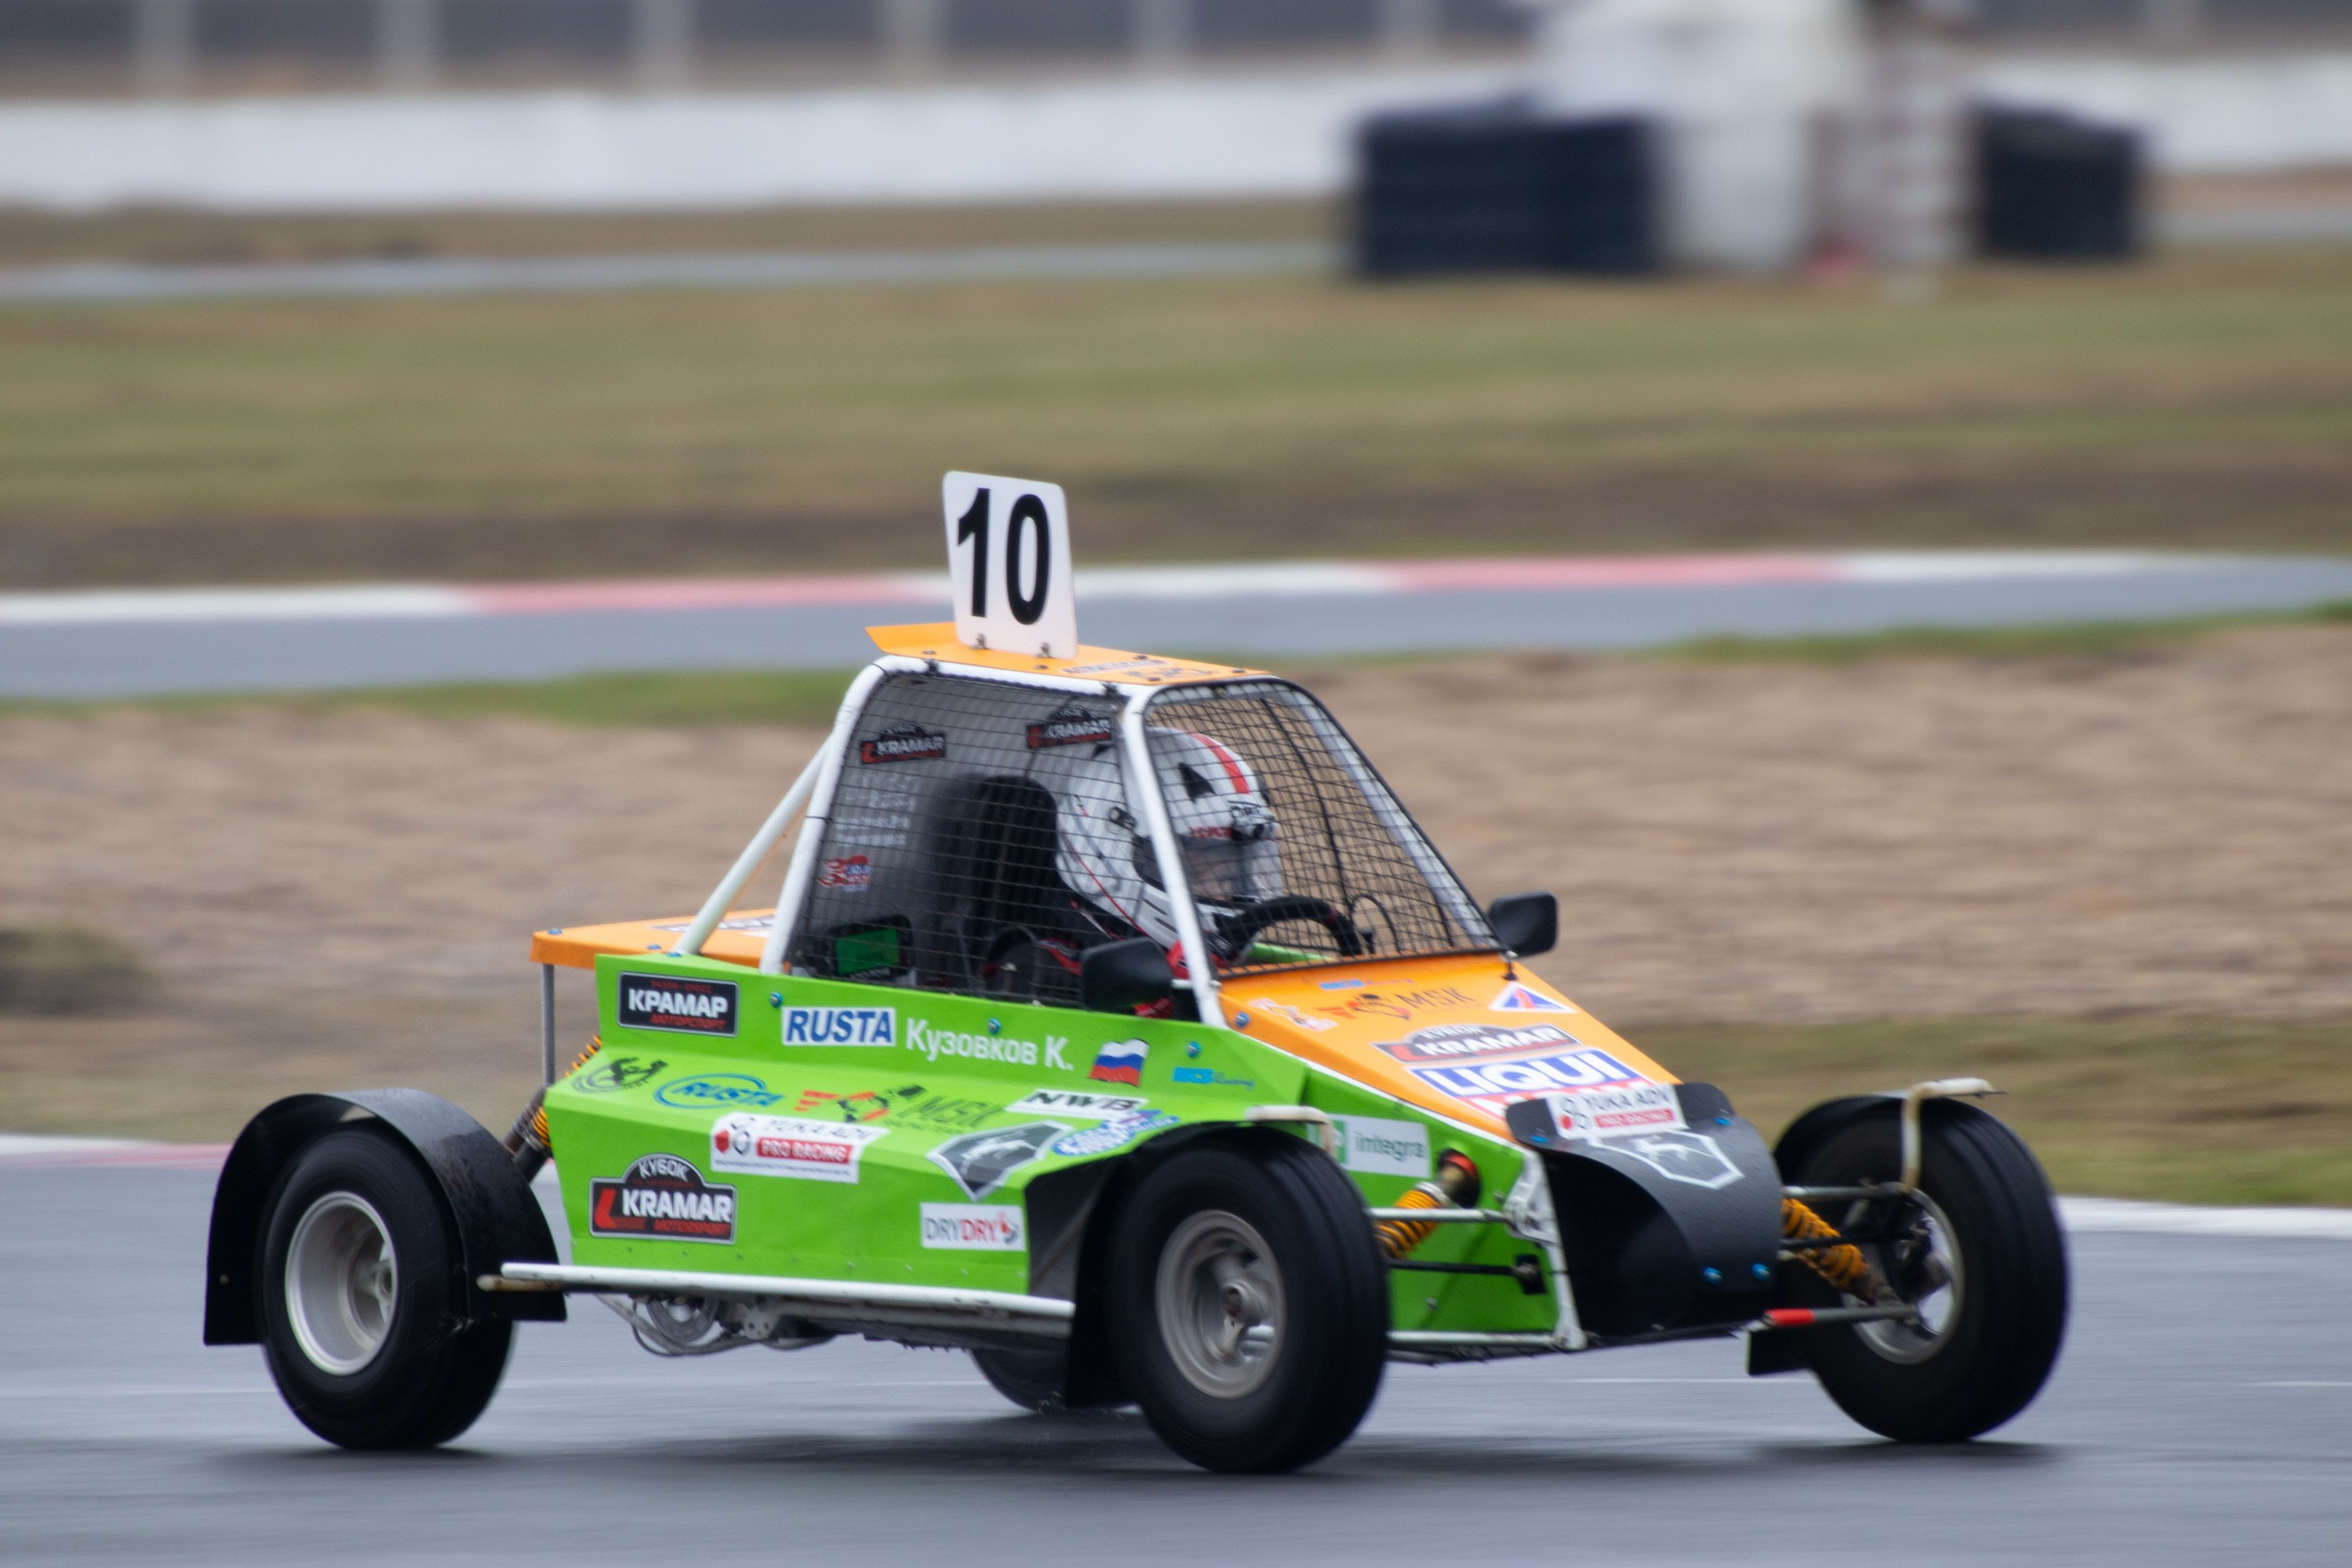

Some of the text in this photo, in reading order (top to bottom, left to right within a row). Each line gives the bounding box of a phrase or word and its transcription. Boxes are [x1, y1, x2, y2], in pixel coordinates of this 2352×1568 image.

[956, 487, 1051, 626] 10
[786, 1010, 893, 1043] RUSTA
[1414, 1026, 1565, 1056] KRAMAR
[906, 1017, 1075, 1071] Кузовков К.
[1419, 1048, 1630, 1097] LIQUI
[761, 1138, 848, 1163] PRO RACING
[1354, 1131, 1427, 1163] integra
[639, 1158, 690, 1182] КУБОК
[621, 1189, 733, 1224] KRAMAR
